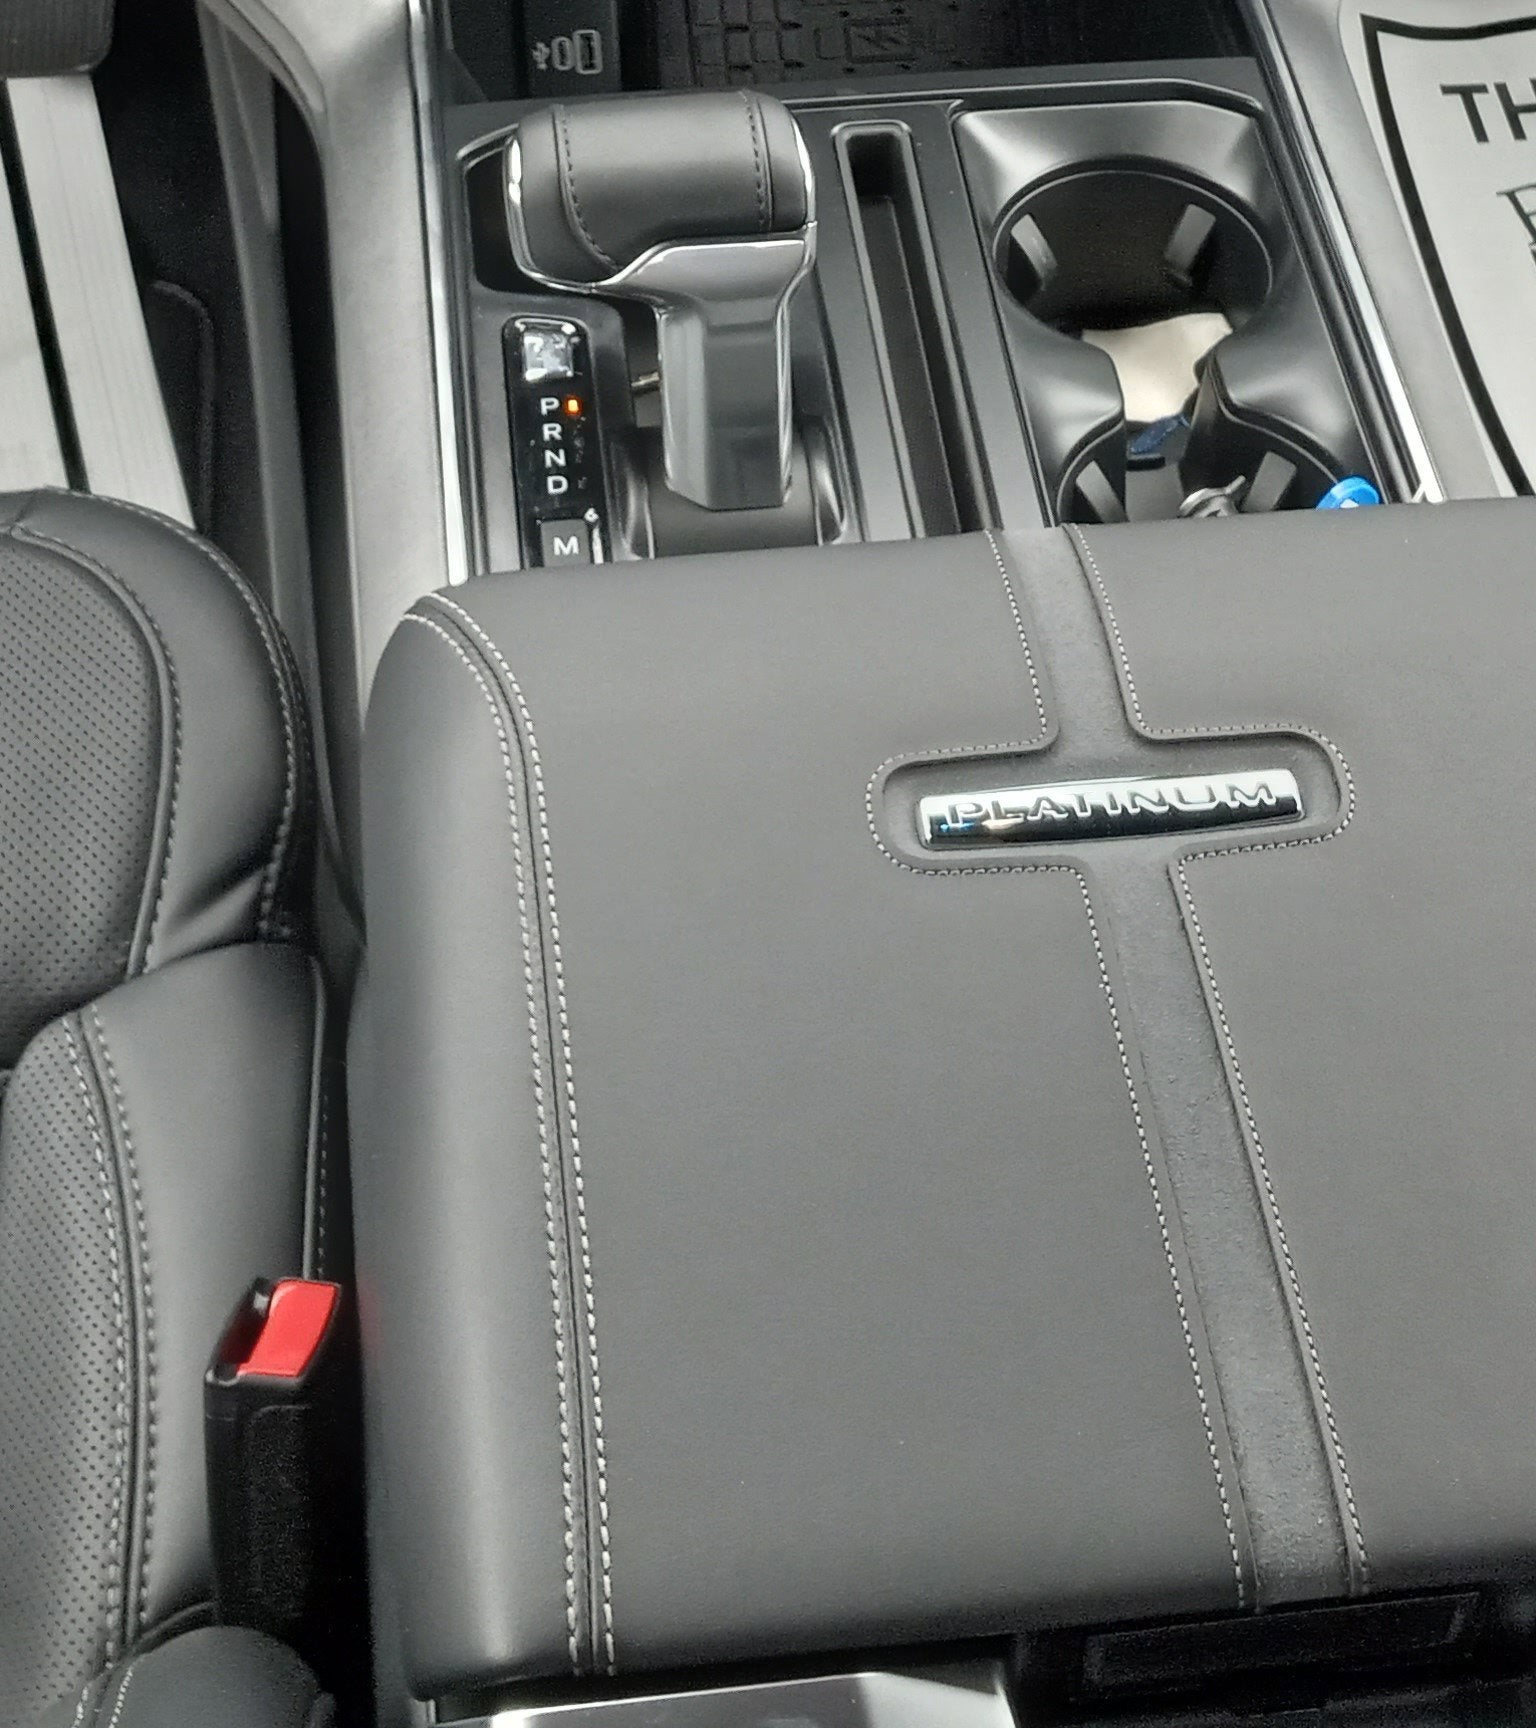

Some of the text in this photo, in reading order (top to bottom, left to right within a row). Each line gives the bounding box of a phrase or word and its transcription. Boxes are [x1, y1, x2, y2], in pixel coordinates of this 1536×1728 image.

[541, 397, 560, 416] P
[543, 423, 563, 442] R
[545, 448, 567, 469] N
[547, 475, 569, 495] D
[553, 535, 580, 556] M
[942, 779, 1279, 828] PLATINUM
